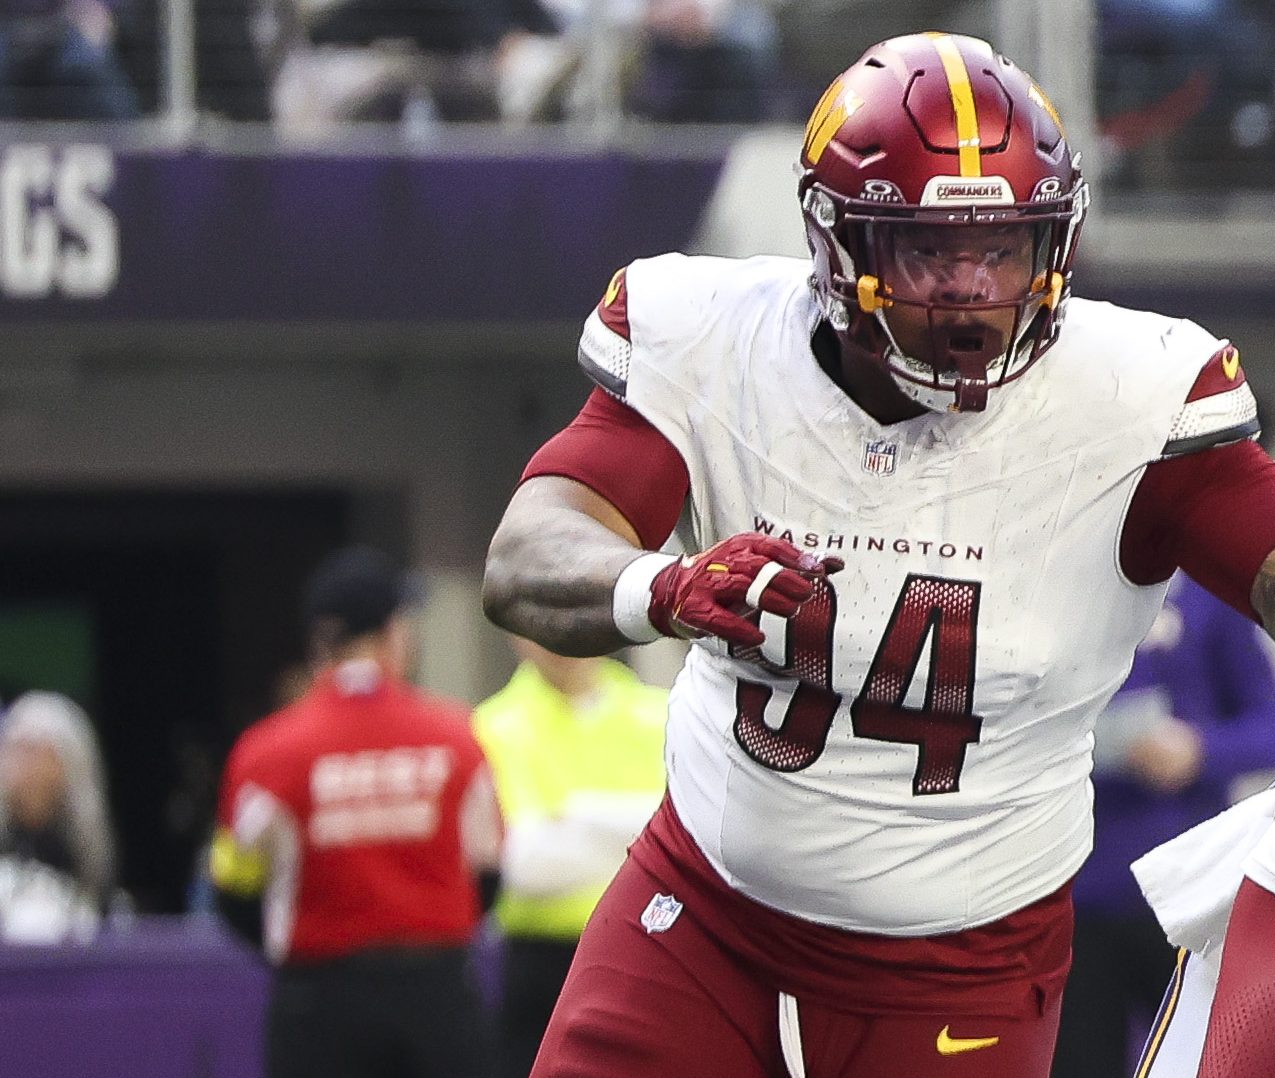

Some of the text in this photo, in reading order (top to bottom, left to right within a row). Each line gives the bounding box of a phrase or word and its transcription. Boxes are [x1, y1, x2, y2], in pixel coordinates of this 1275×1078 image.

[936, 184, 1003, 200] COMMANDERS
[753, 516, 984, 561] WASHINGTON
[728, 572, 984, 797] 94
